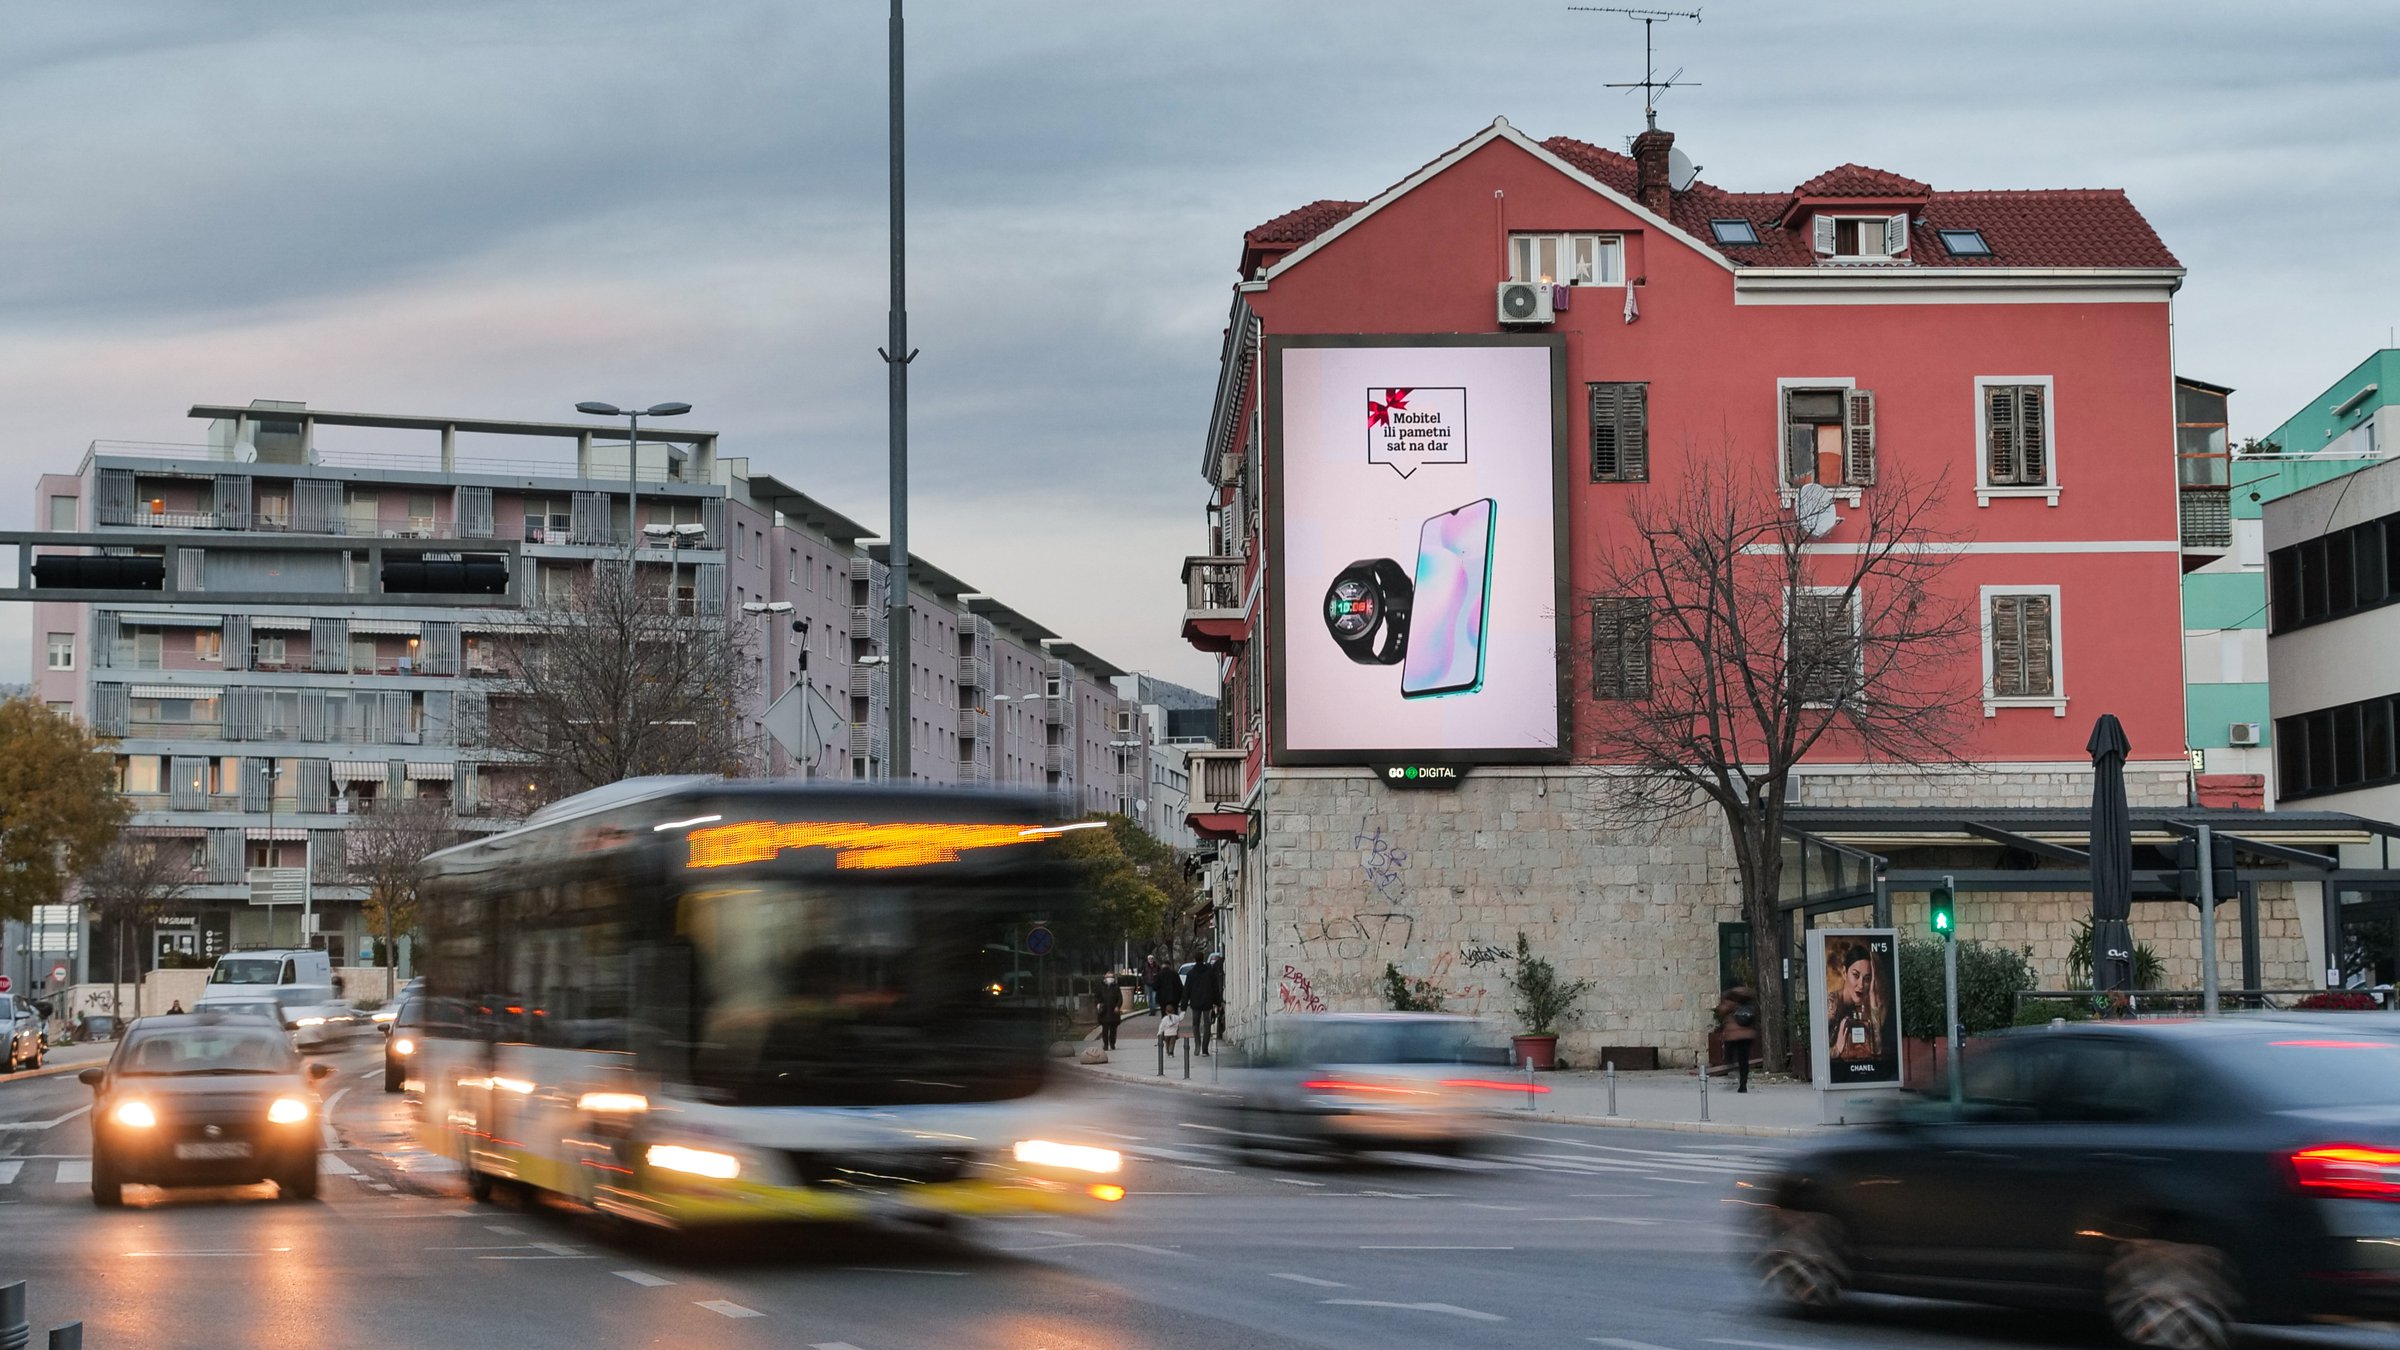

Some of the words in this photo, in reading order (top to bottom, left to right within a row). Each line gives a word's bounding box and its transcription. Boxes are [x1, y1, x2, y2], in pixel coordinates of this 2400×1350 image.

[1393, 412, 1441, 424] Mobitel
[1383, 426, 1396, 438] ili
[1399, 426, 1451, 440] pametni
[1387, 440, 1406, 451] sat
[1409, 442, 1425, 451] na
[1427, 440, 1448, 451] dar
[1388, 767, 1404, 778] GO
[1419, 767, 1457, 778] DIGITAL
[1850, 1064, 1875, 1072] CHANEL
